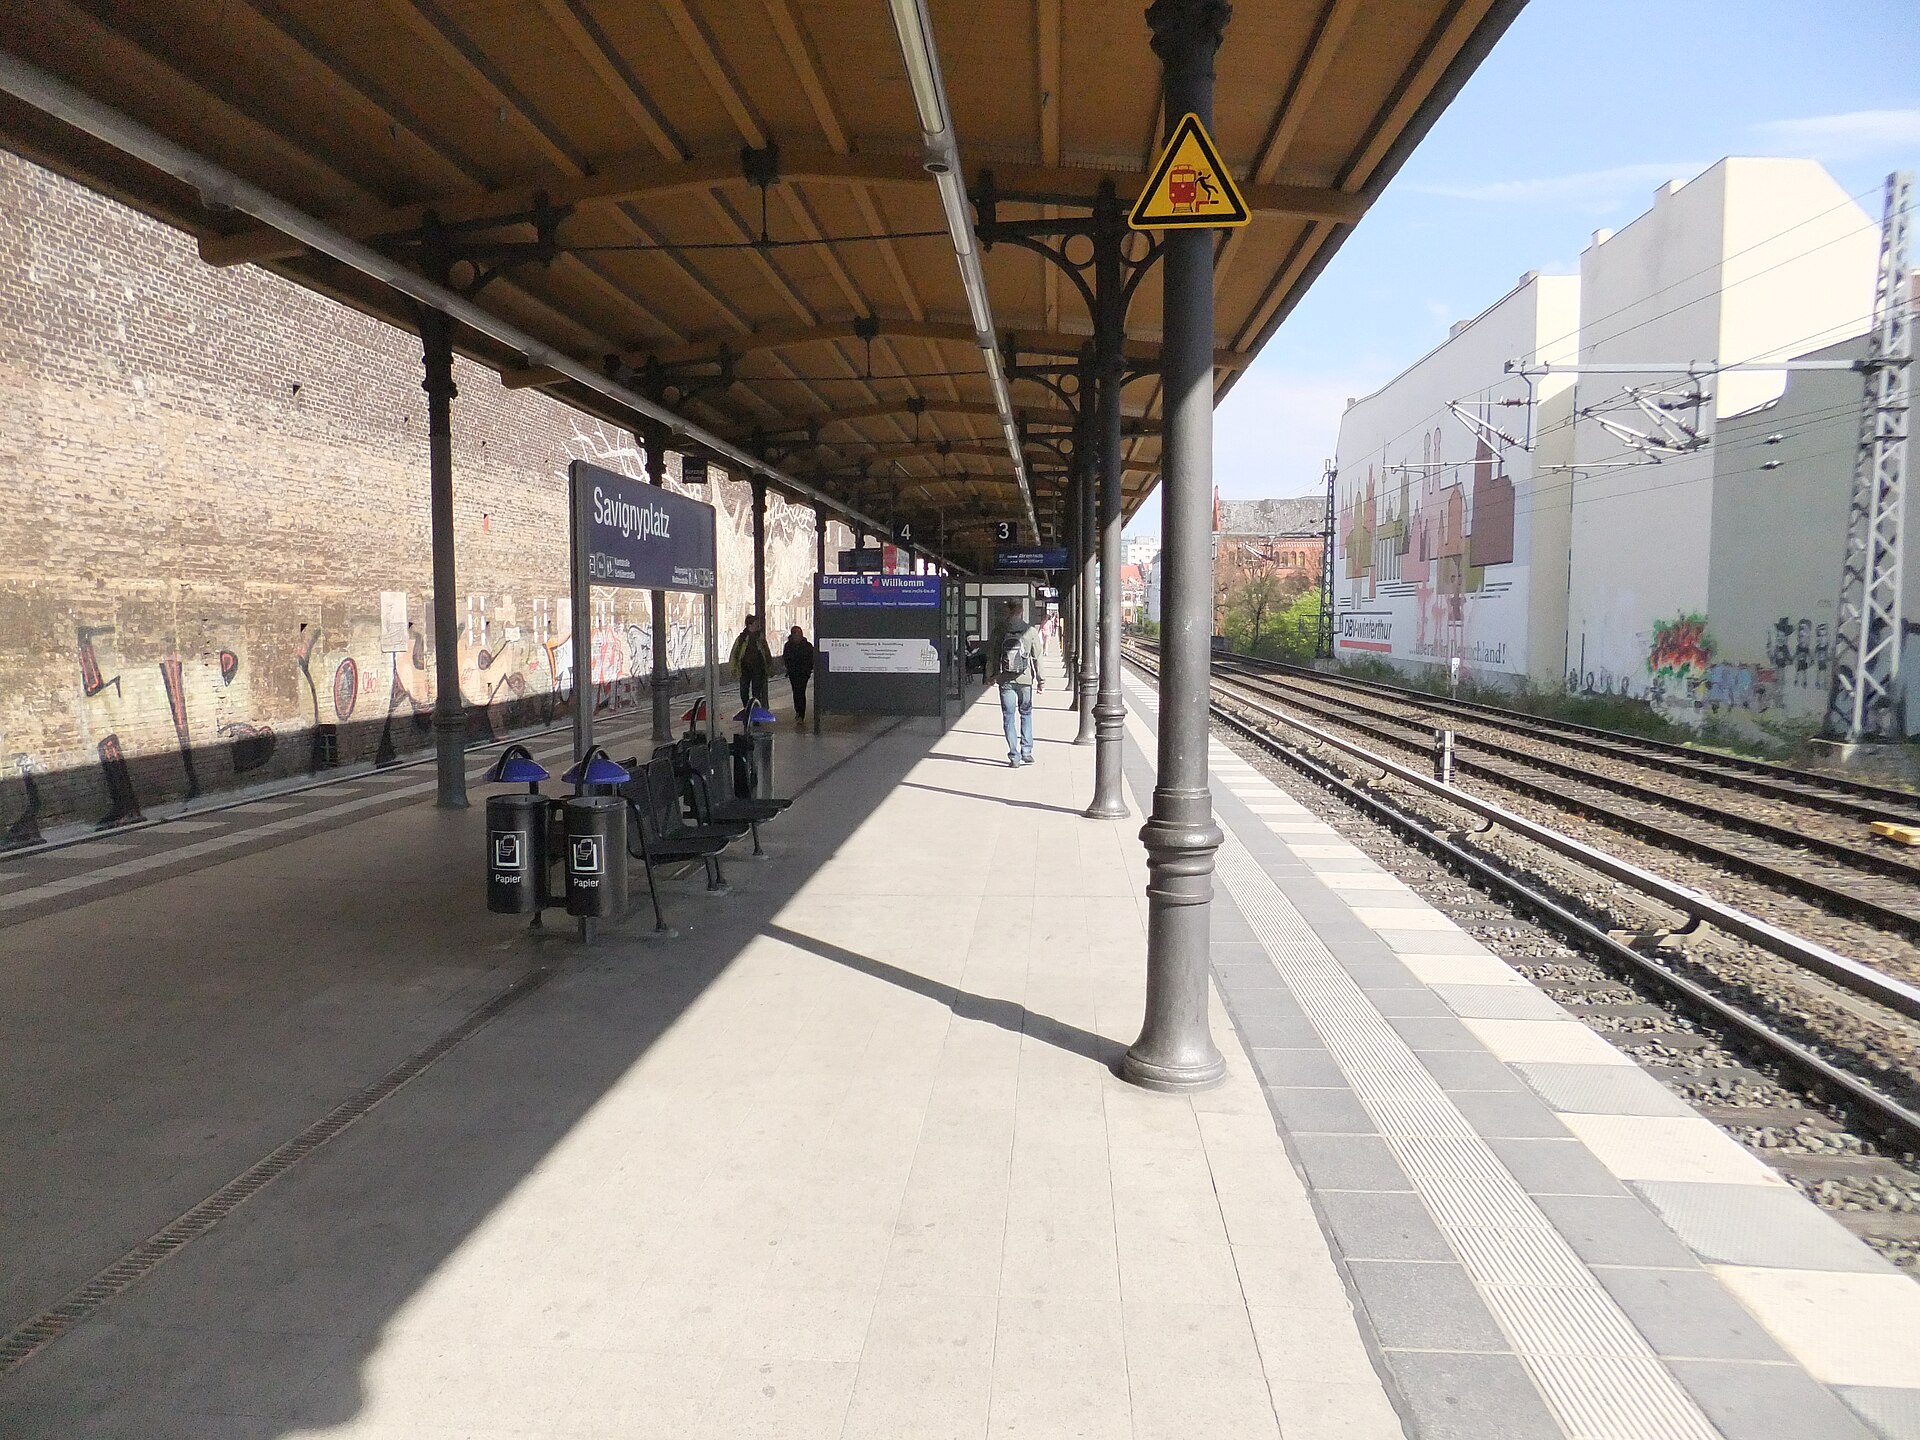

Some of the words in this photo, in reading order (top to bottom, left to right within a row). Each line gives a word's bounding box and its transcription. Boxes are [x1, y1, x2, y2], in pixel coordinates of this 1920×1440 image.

[593, 486, 670, 541] Savignyplatz
[900, 523, 911, 540] 4
[998, 522, 1010, 539] 3
[823, 576, 866, 585] Bredereck
[881, 578, 925, 587] Willkomm
[495, 873, 522, 885] Papier
[573, 877, 599, 888] Papier
